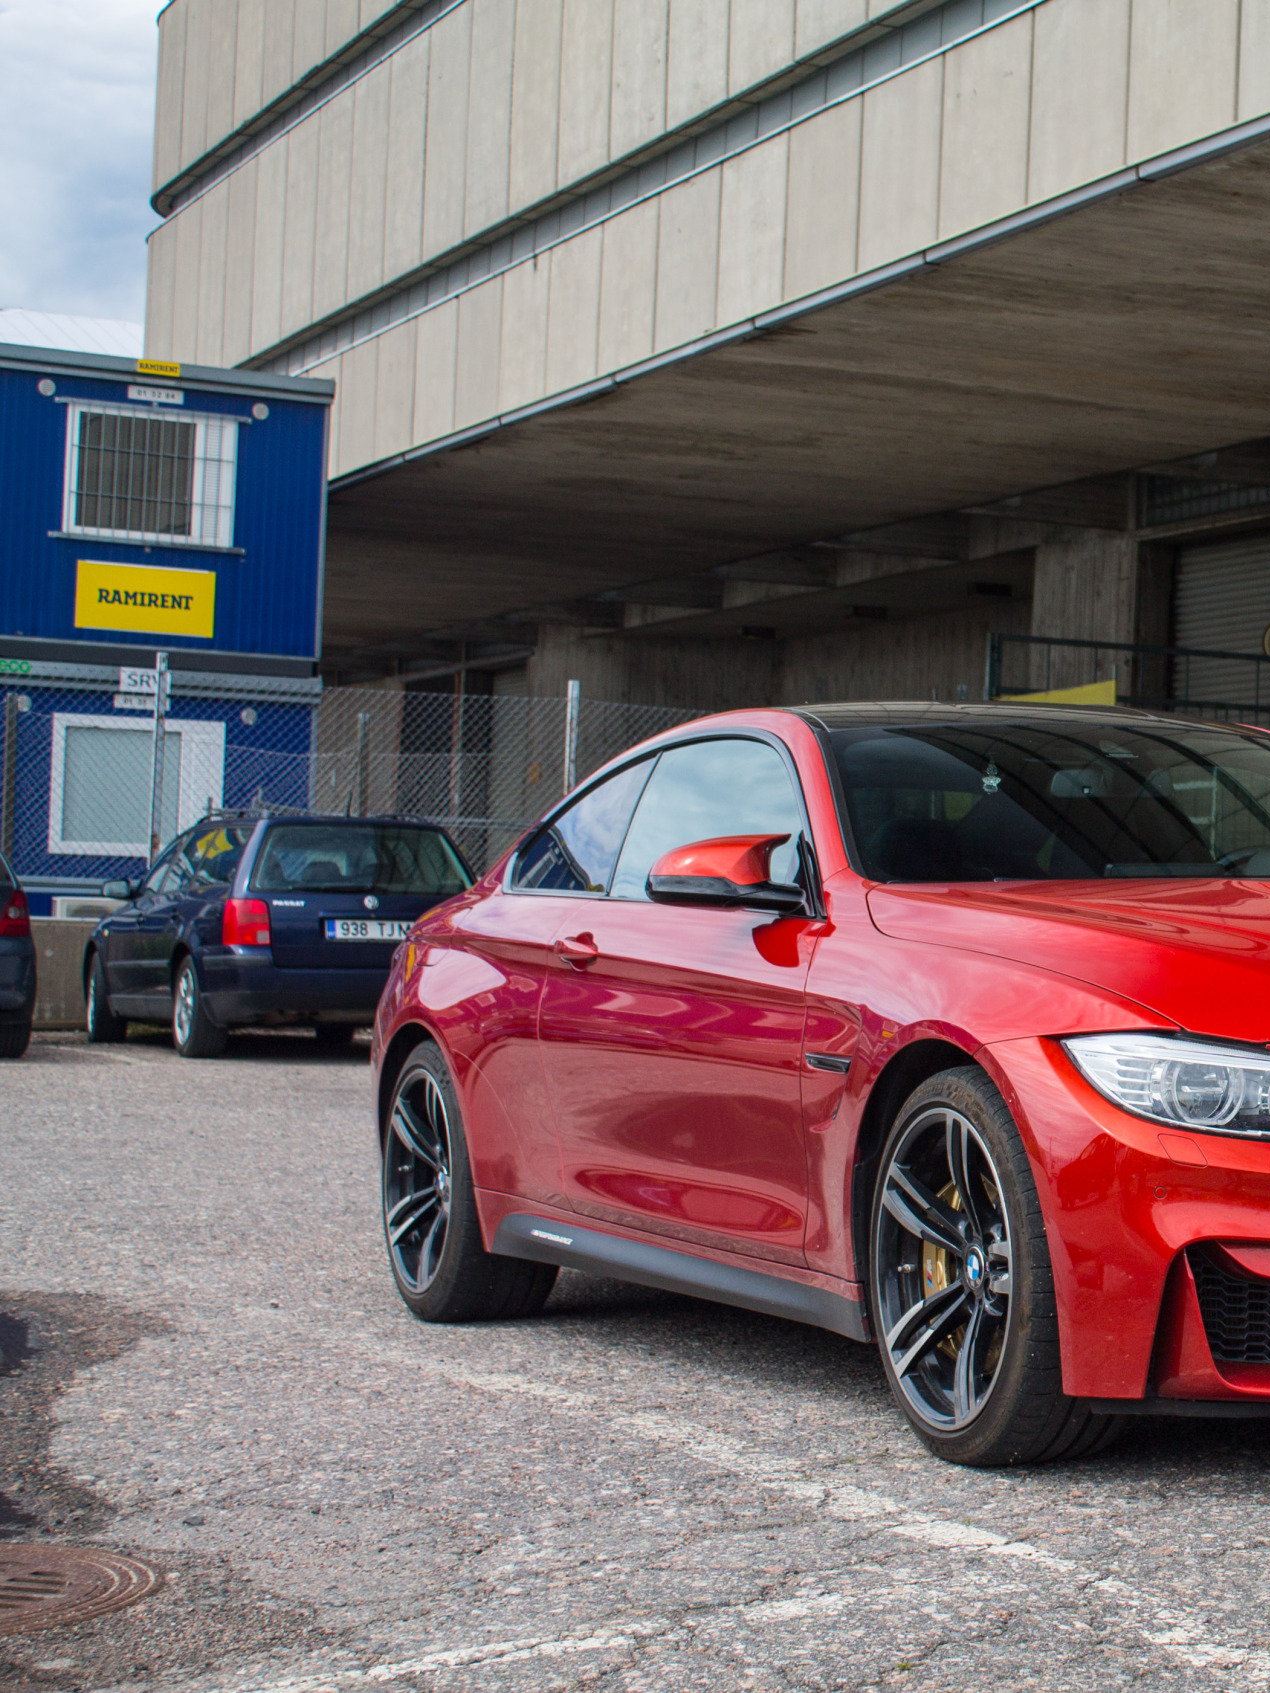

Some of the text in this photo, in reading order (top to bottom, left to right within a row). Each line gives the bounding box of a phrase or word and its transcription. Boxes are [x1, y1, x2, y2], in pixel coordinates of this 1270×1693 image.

[139, 362, 179, 373] RAMIRENT
[97, 588, 194, 610] RAMIRENT
[340, 922, 369, 937] 938
